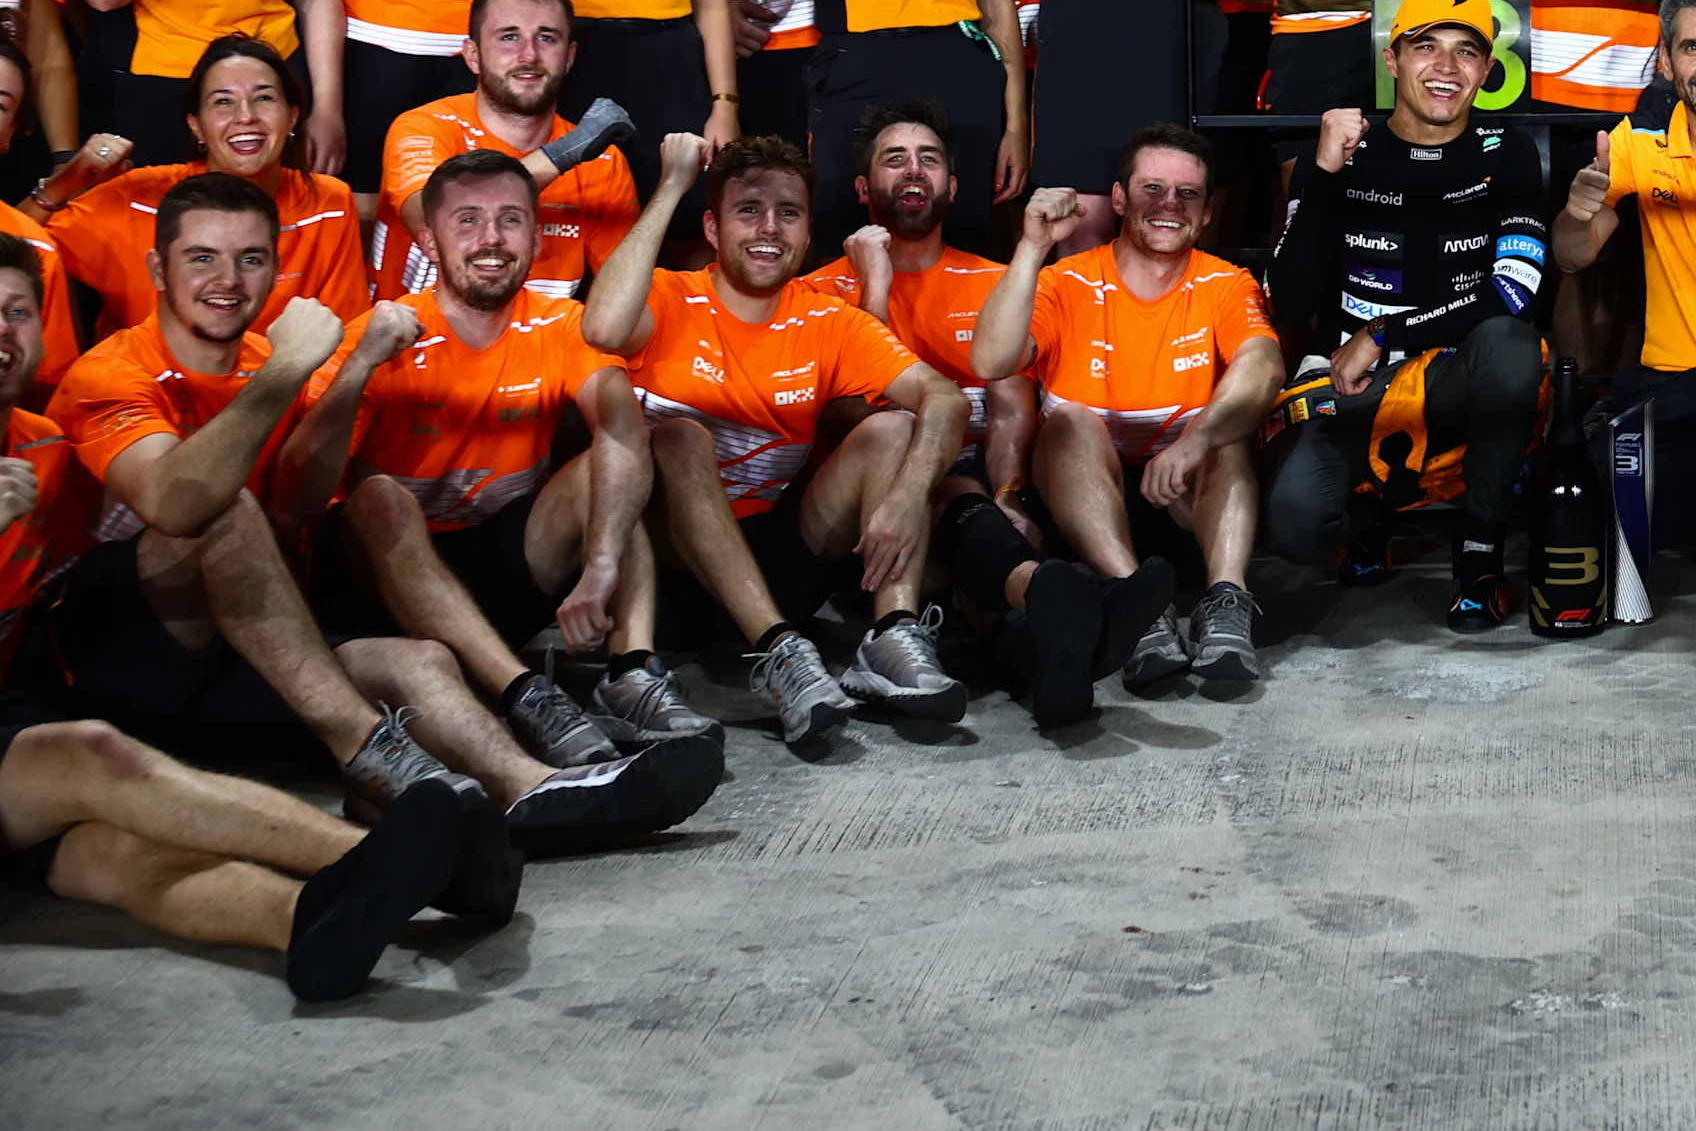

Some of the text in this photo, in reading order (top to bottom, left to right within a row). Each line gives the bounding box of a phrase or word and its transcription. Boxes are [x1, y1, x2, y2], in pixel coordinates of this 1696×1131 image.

[1413, 150, 1440, 159] Hilton
[1346, 188, 1403, 206] android
[543, 223, 581, 238] OKX
[1500, 238, 1545, 259] alteryx
[1361, 278, 1393, 291] WORLD
[1405, 293, 1477, 326] RICHARD MILLE
[693, 356, 724, 383] DELL
[1173, 352, 1210, 372] OKX
[775, 387, 815, 406] OKX
[1615, 455, 1639, 471] 3
[1545, 547, 1599, 585] 3
